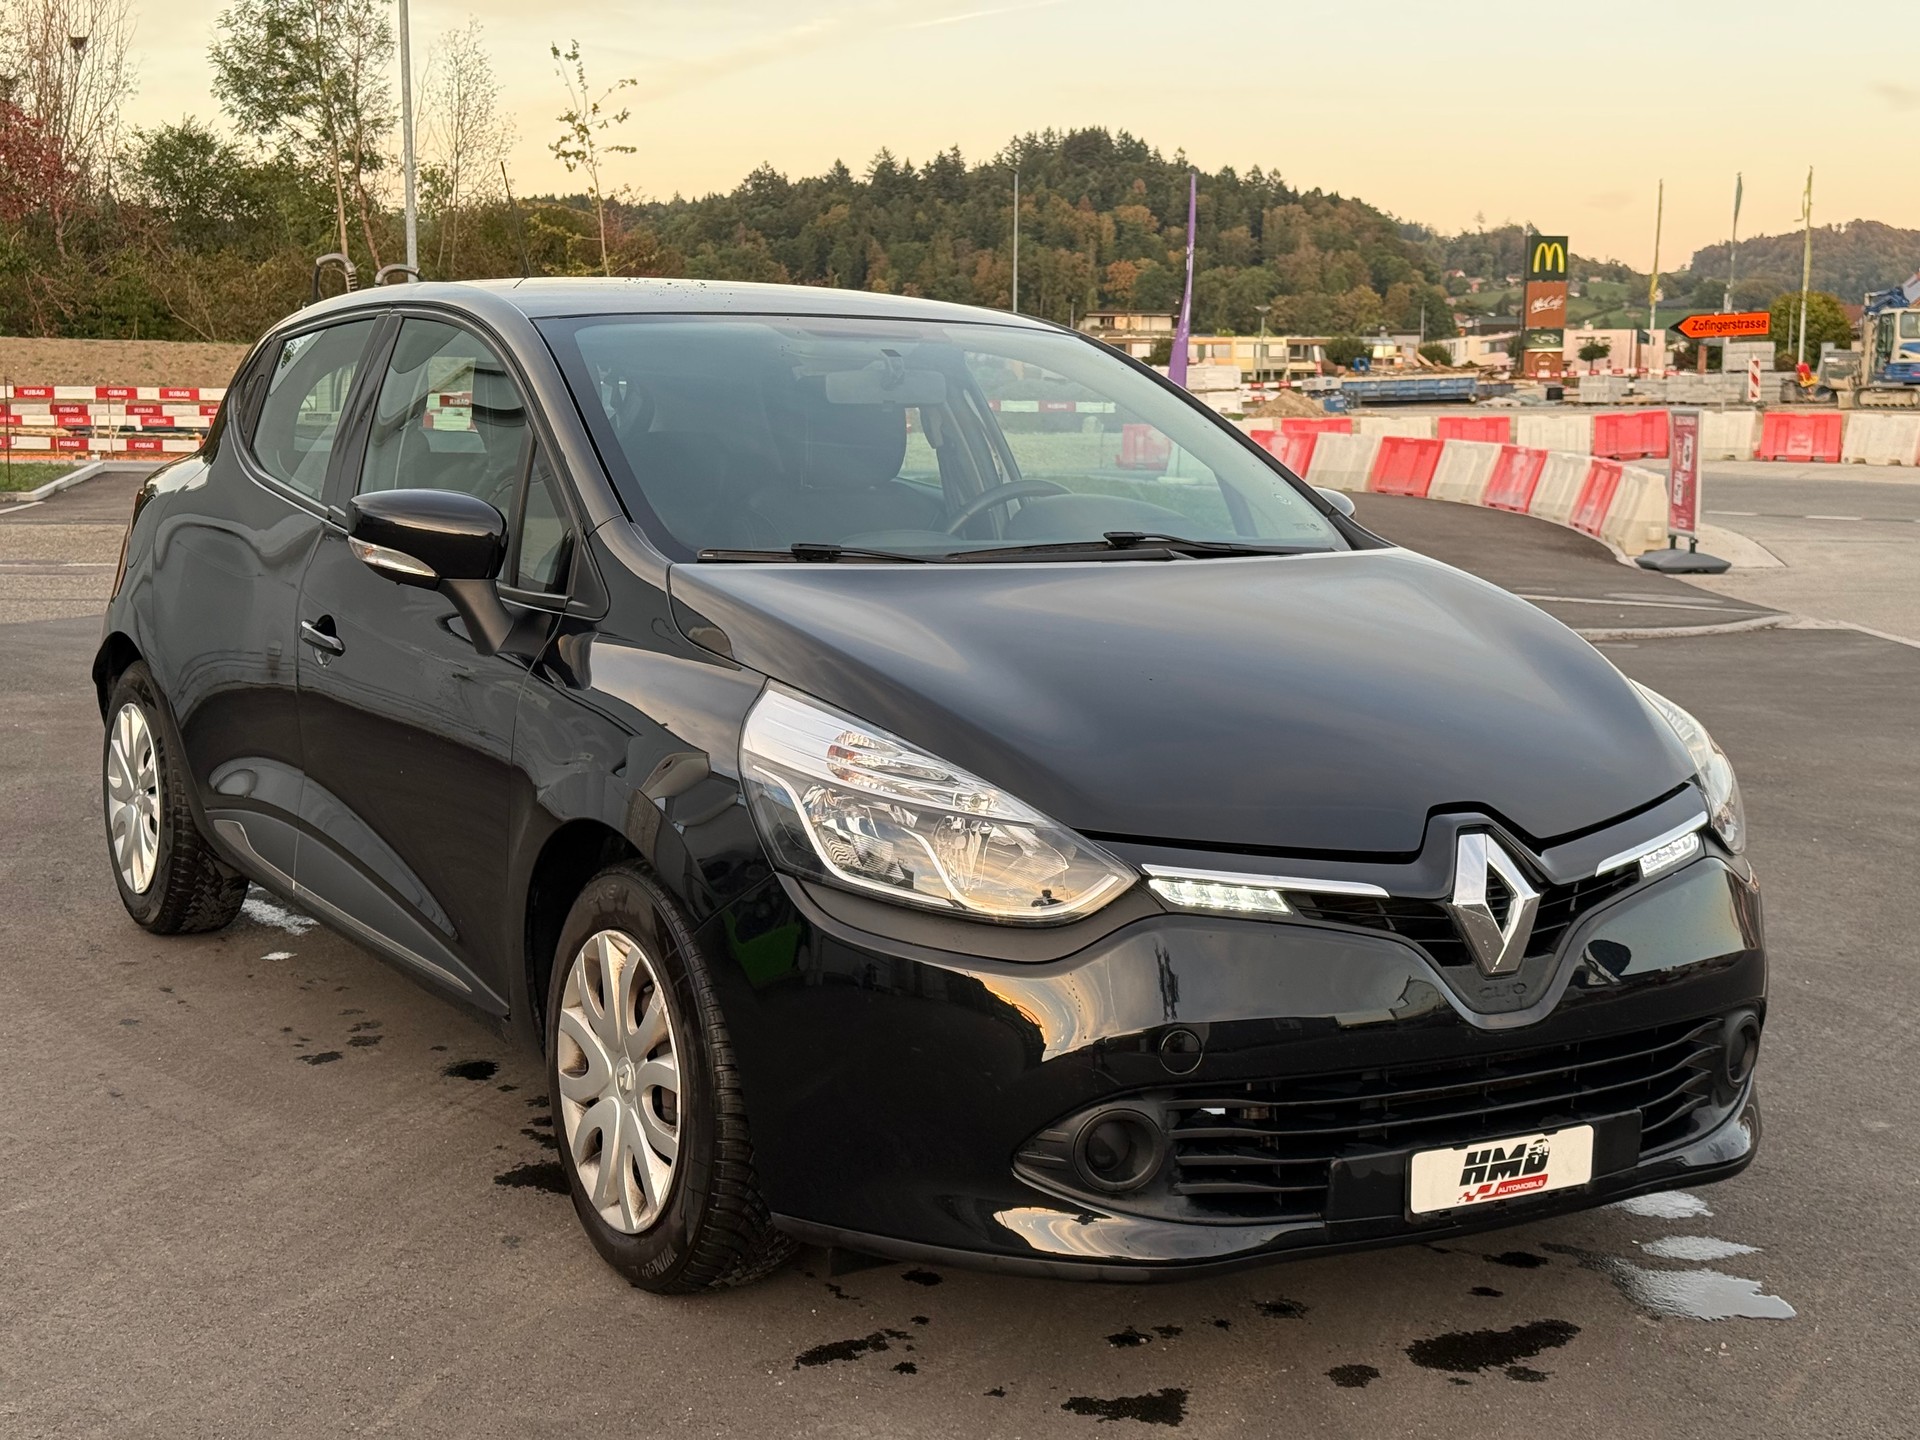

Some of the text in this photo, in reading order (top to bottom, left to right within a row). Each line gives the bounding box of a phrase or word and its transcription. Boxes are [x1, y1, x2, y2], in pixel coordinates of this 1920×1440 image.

[1691, 319, 1767, 333] Zofingerstrasse
[168, 390, 191, 398] KIBAG
[58, 406, 79, 414] KIBAG
[1497, 1178, 1544, 1194] AUTOMOBILE
